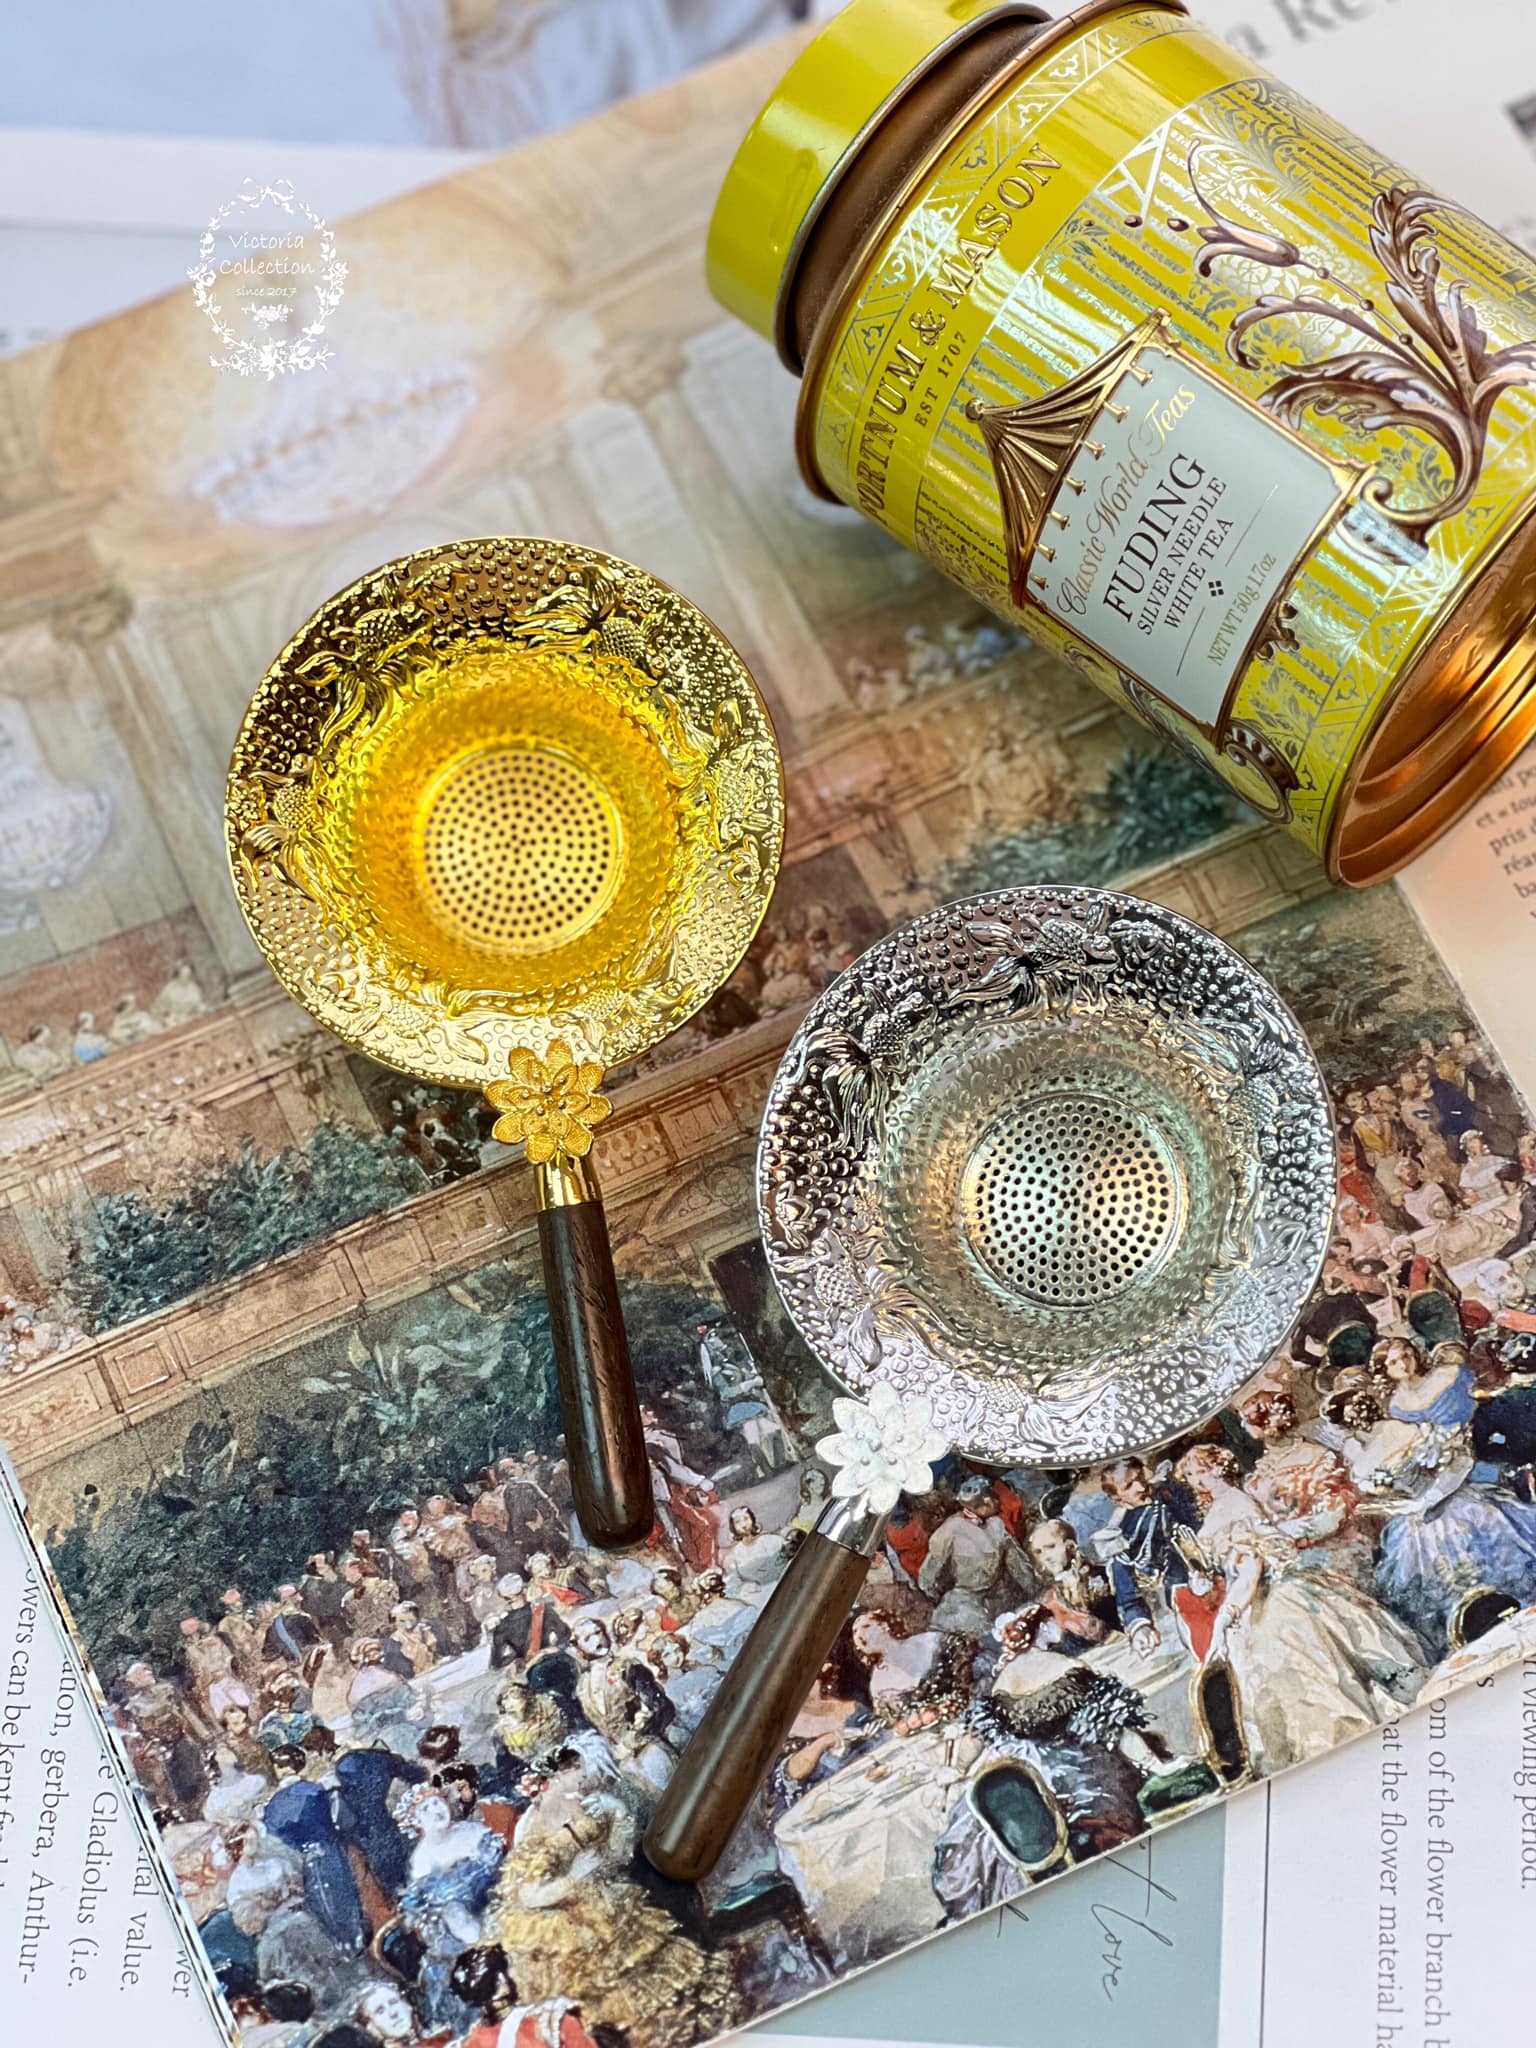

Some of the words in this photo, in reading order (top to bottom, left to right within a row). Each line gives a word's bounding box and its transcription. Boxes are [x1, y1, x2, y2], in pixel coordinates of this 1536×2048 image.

[926, 142, 1063, 309] MASON
[909, 309, 946, 347] &
[914, 386, 938, 428] EST
[937, 331, 965, 378] 1707
[857, 339, 926, 527] FORTNUM
[1056, 536, 1106, 615] Classic
[1086, 432, 1149, 537] World
[1138, 383, 1196, 457] Teas
[1103, 452, 1206, 623] FUDING
[1137, 566, 1176, 636] SILVER
[1167, 476, 1227, 567] NEEDLE
[1164, 562, 1206, 630] WHITE
[1197, 517, 1234, 561] TEA
[1207, 633, 1231, 666] NET
[1221, 608, 1244, 641] WT
[15, 1563, 40, 1644] owers
[7, 1650, 29, 1697] can
[49, 1655, 77, 1737] ation,
[1, 1705, 31, 1736] be
[32, 1748, 69, 1858] gerbera,
[1381, 1761, 1408, 1802] the
[1428, 1751, 1455, 1783] of
[1428, 1788, 1455, 1829] the
[77, 1791, 119, 1924] Gladiolus
[1380, 1812, 1408, 1896] flower
[1426, 1839, 1454, 1923] flower
[18, 1870, 54, 1984] Anthur-
[67, 1937, 100, 1987] (i.e.
[119, 1911, 152, 1991] value.
[1377, 1904, 1404, 2013] material
[1424, 1933, 1452, 2027] branch
